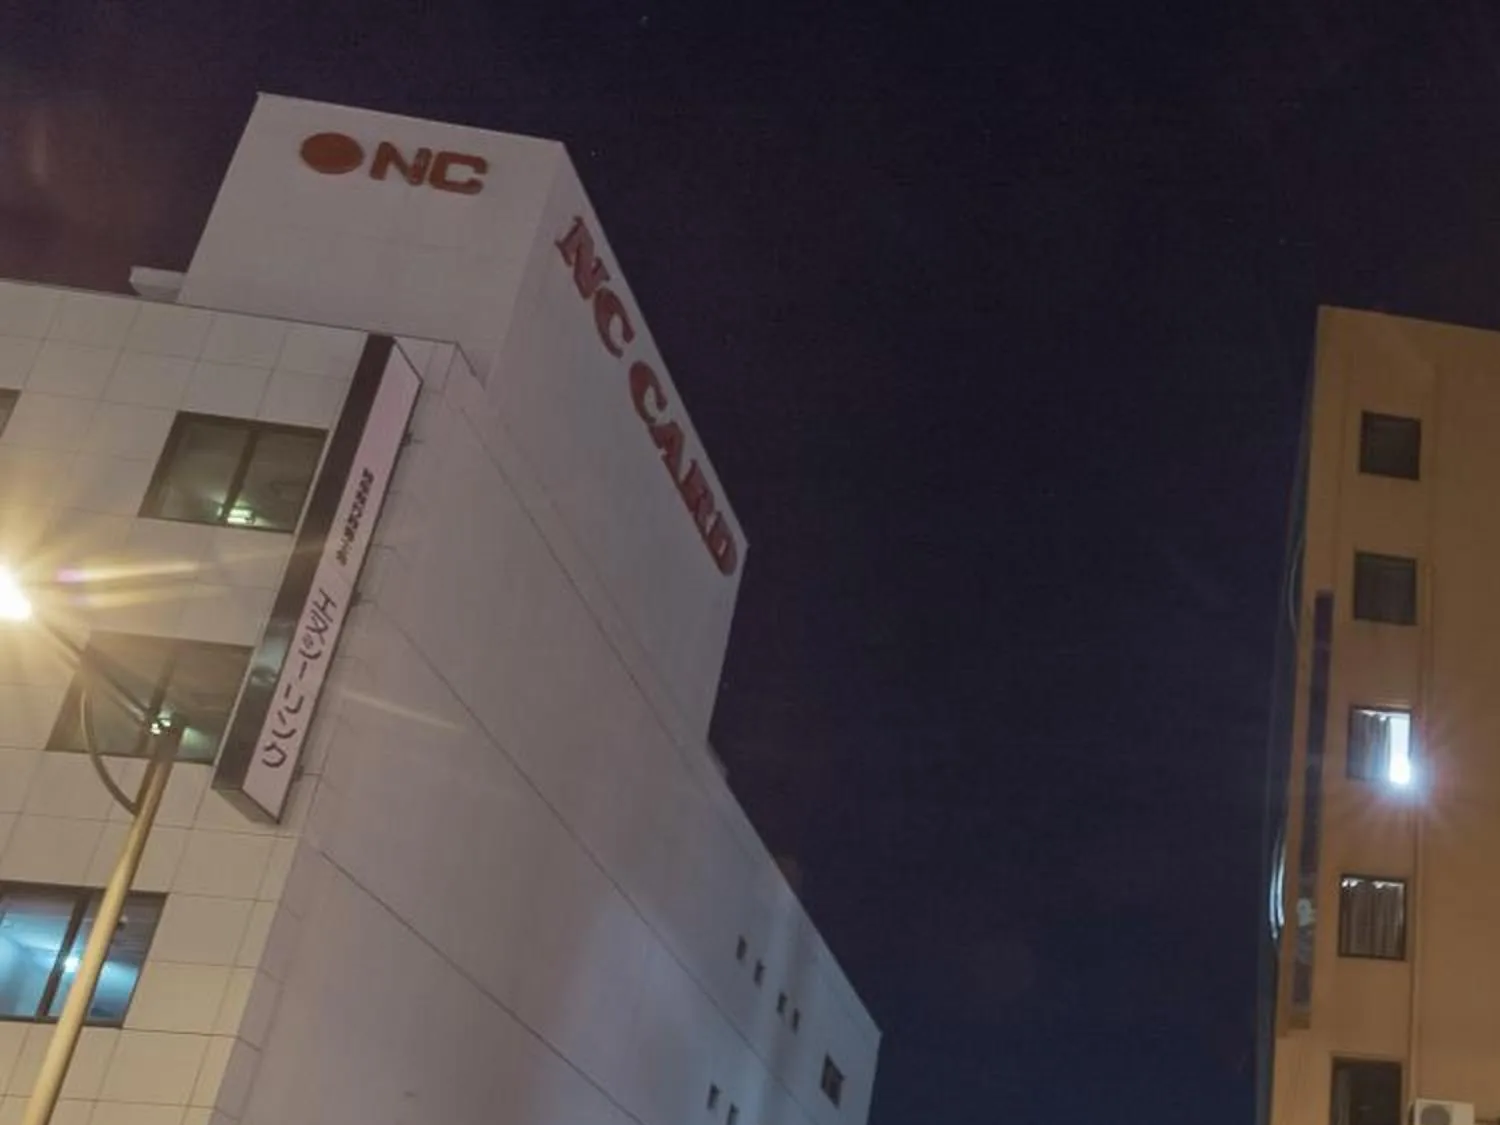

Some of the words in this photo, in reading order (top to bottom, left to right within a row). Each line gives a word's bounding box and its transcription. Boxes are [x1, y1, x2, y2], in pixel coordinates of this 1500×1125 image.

[370, 141, 489, 195] NC
[554, 215, 636, 359] NC
[628, 360, 739, 578] CARD
